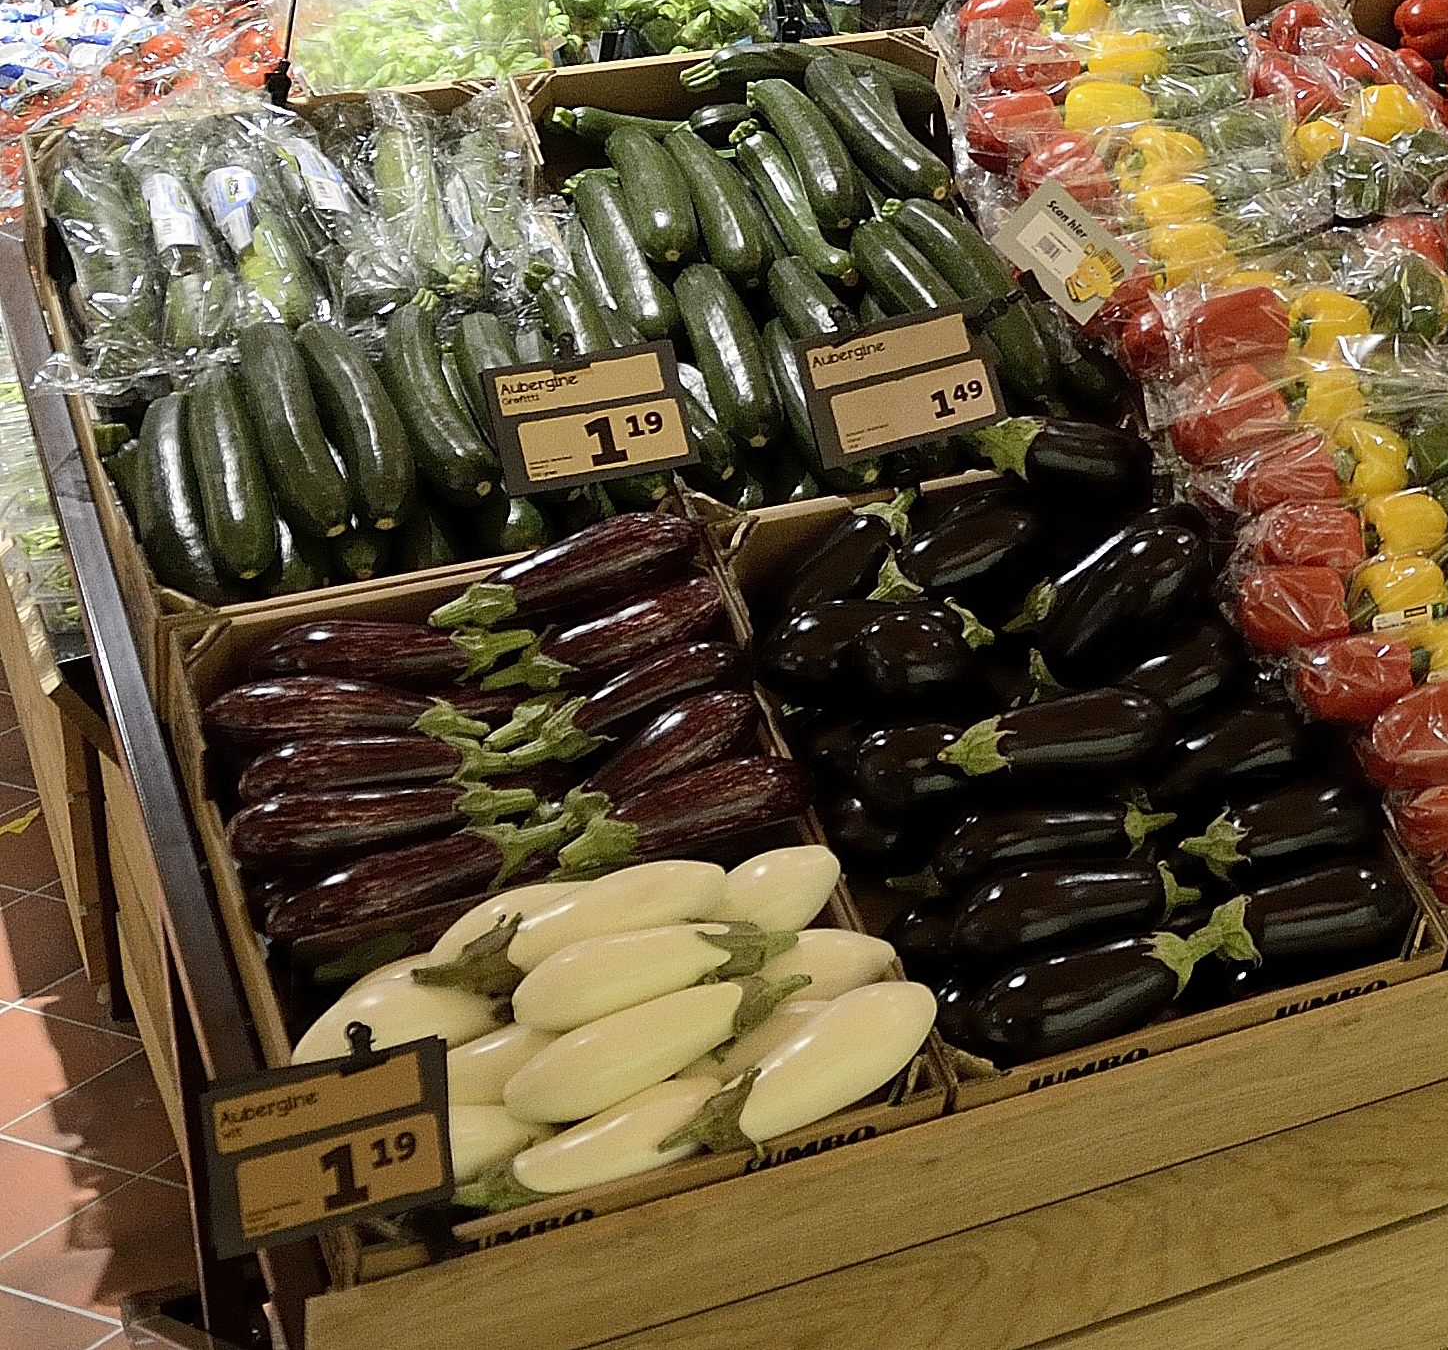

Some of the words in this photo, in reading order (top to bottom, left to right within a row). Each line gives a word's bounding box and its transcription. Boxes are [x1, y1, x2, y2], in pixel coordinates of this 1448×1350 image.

[1046, 200, 1070, 222] Scan
[1067, 219, 1087, 238] hier
[812, 339, 885, 369] Aubergine
[501, 374, 578, 395] Aubergine
[220, 1090, 318, 1126] Aubergine
